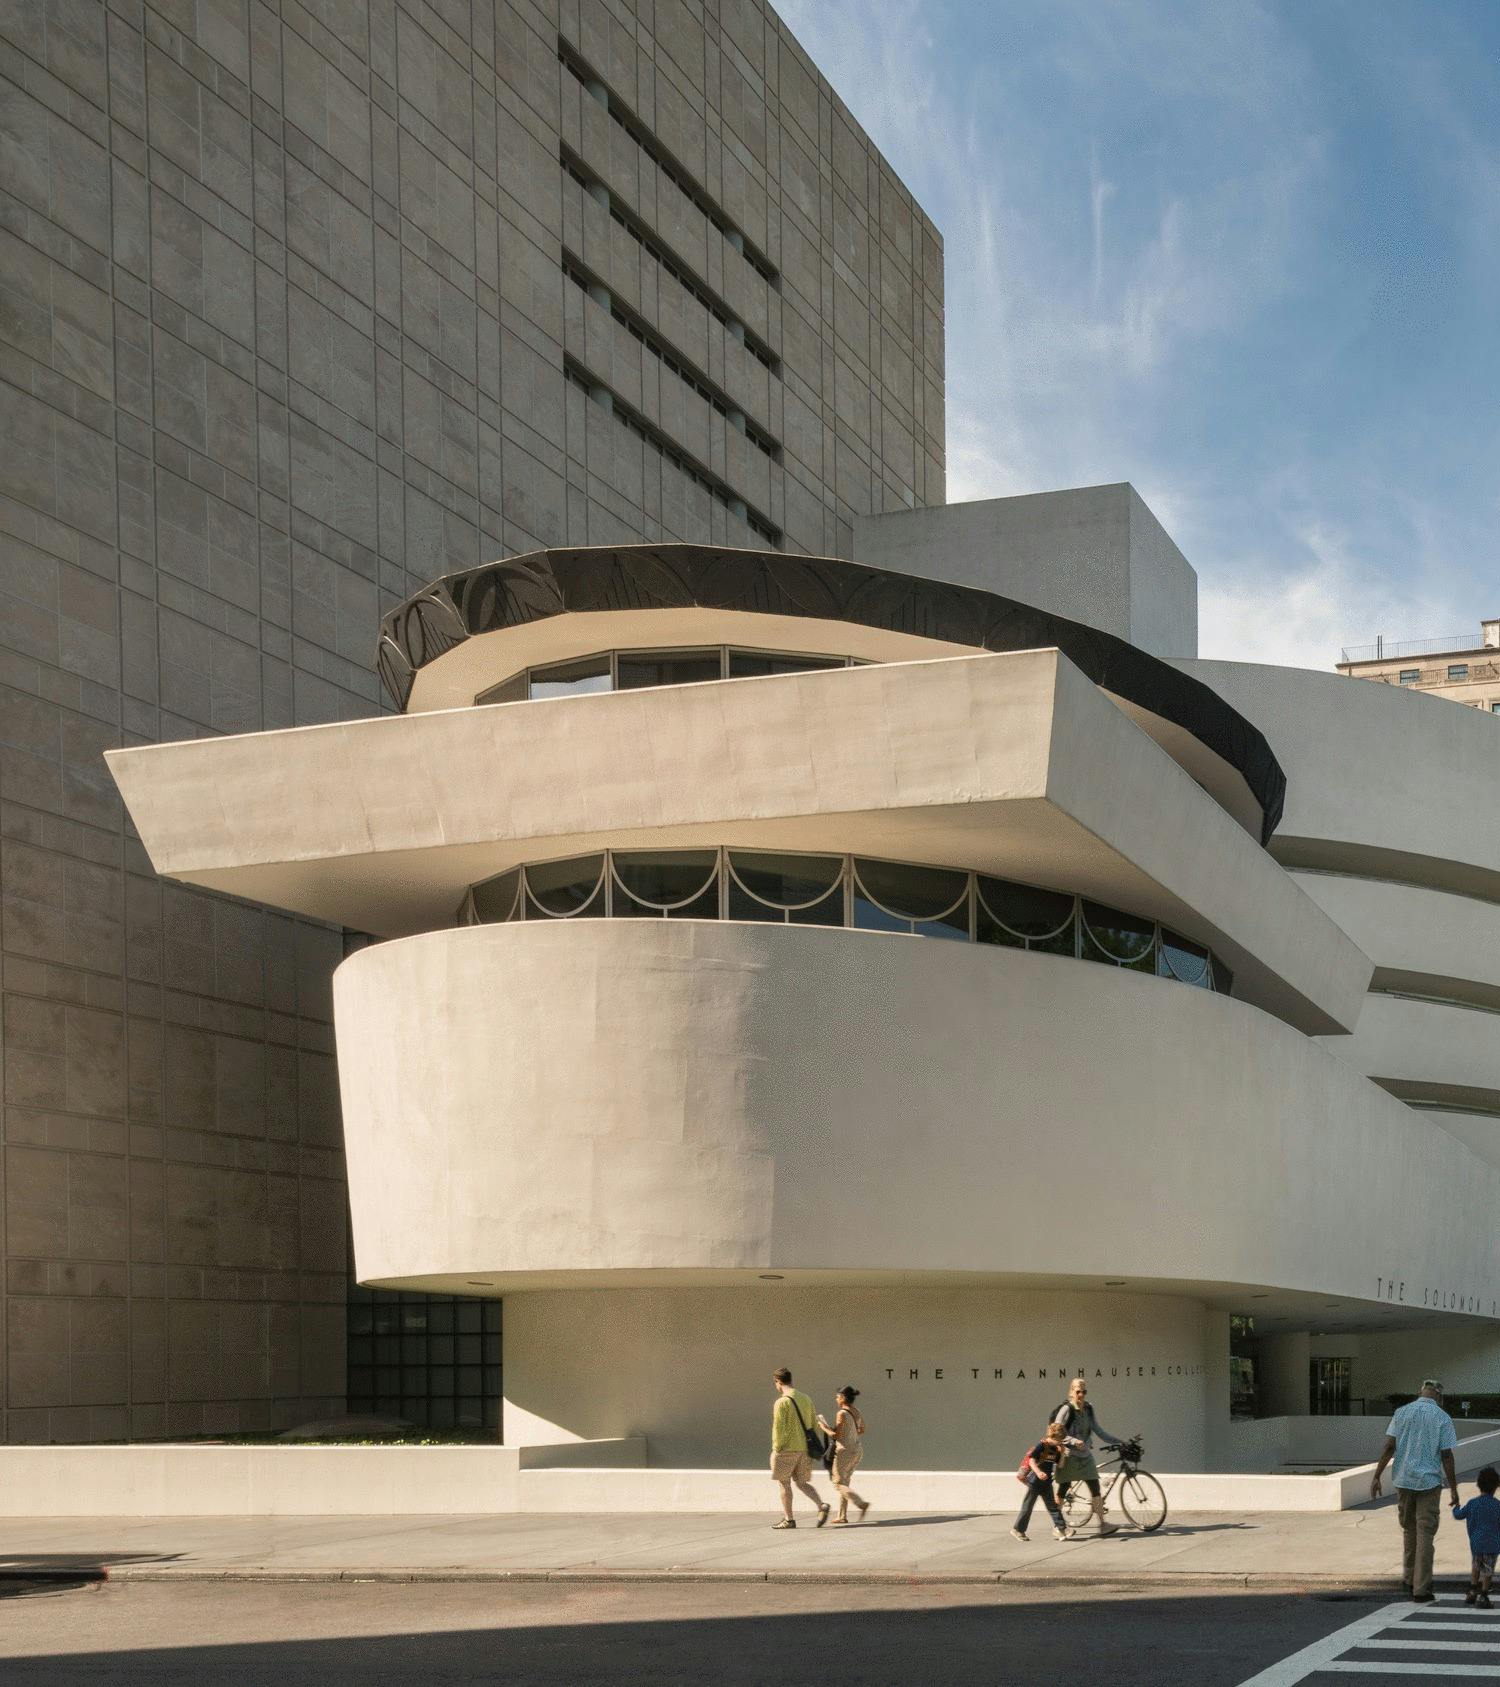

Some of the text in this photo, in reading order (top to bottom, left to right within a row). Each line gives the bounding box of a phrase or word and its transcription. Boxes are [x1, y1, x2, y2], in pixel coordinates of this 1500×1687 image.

[1377, 1277, 1405, 1301] THE
[1424, 1287, 1480, 1313] SOLOMON
[885, 1368, 944, 1380] THE
[971, 1366, 1157, 1380] THANNHAUSER
